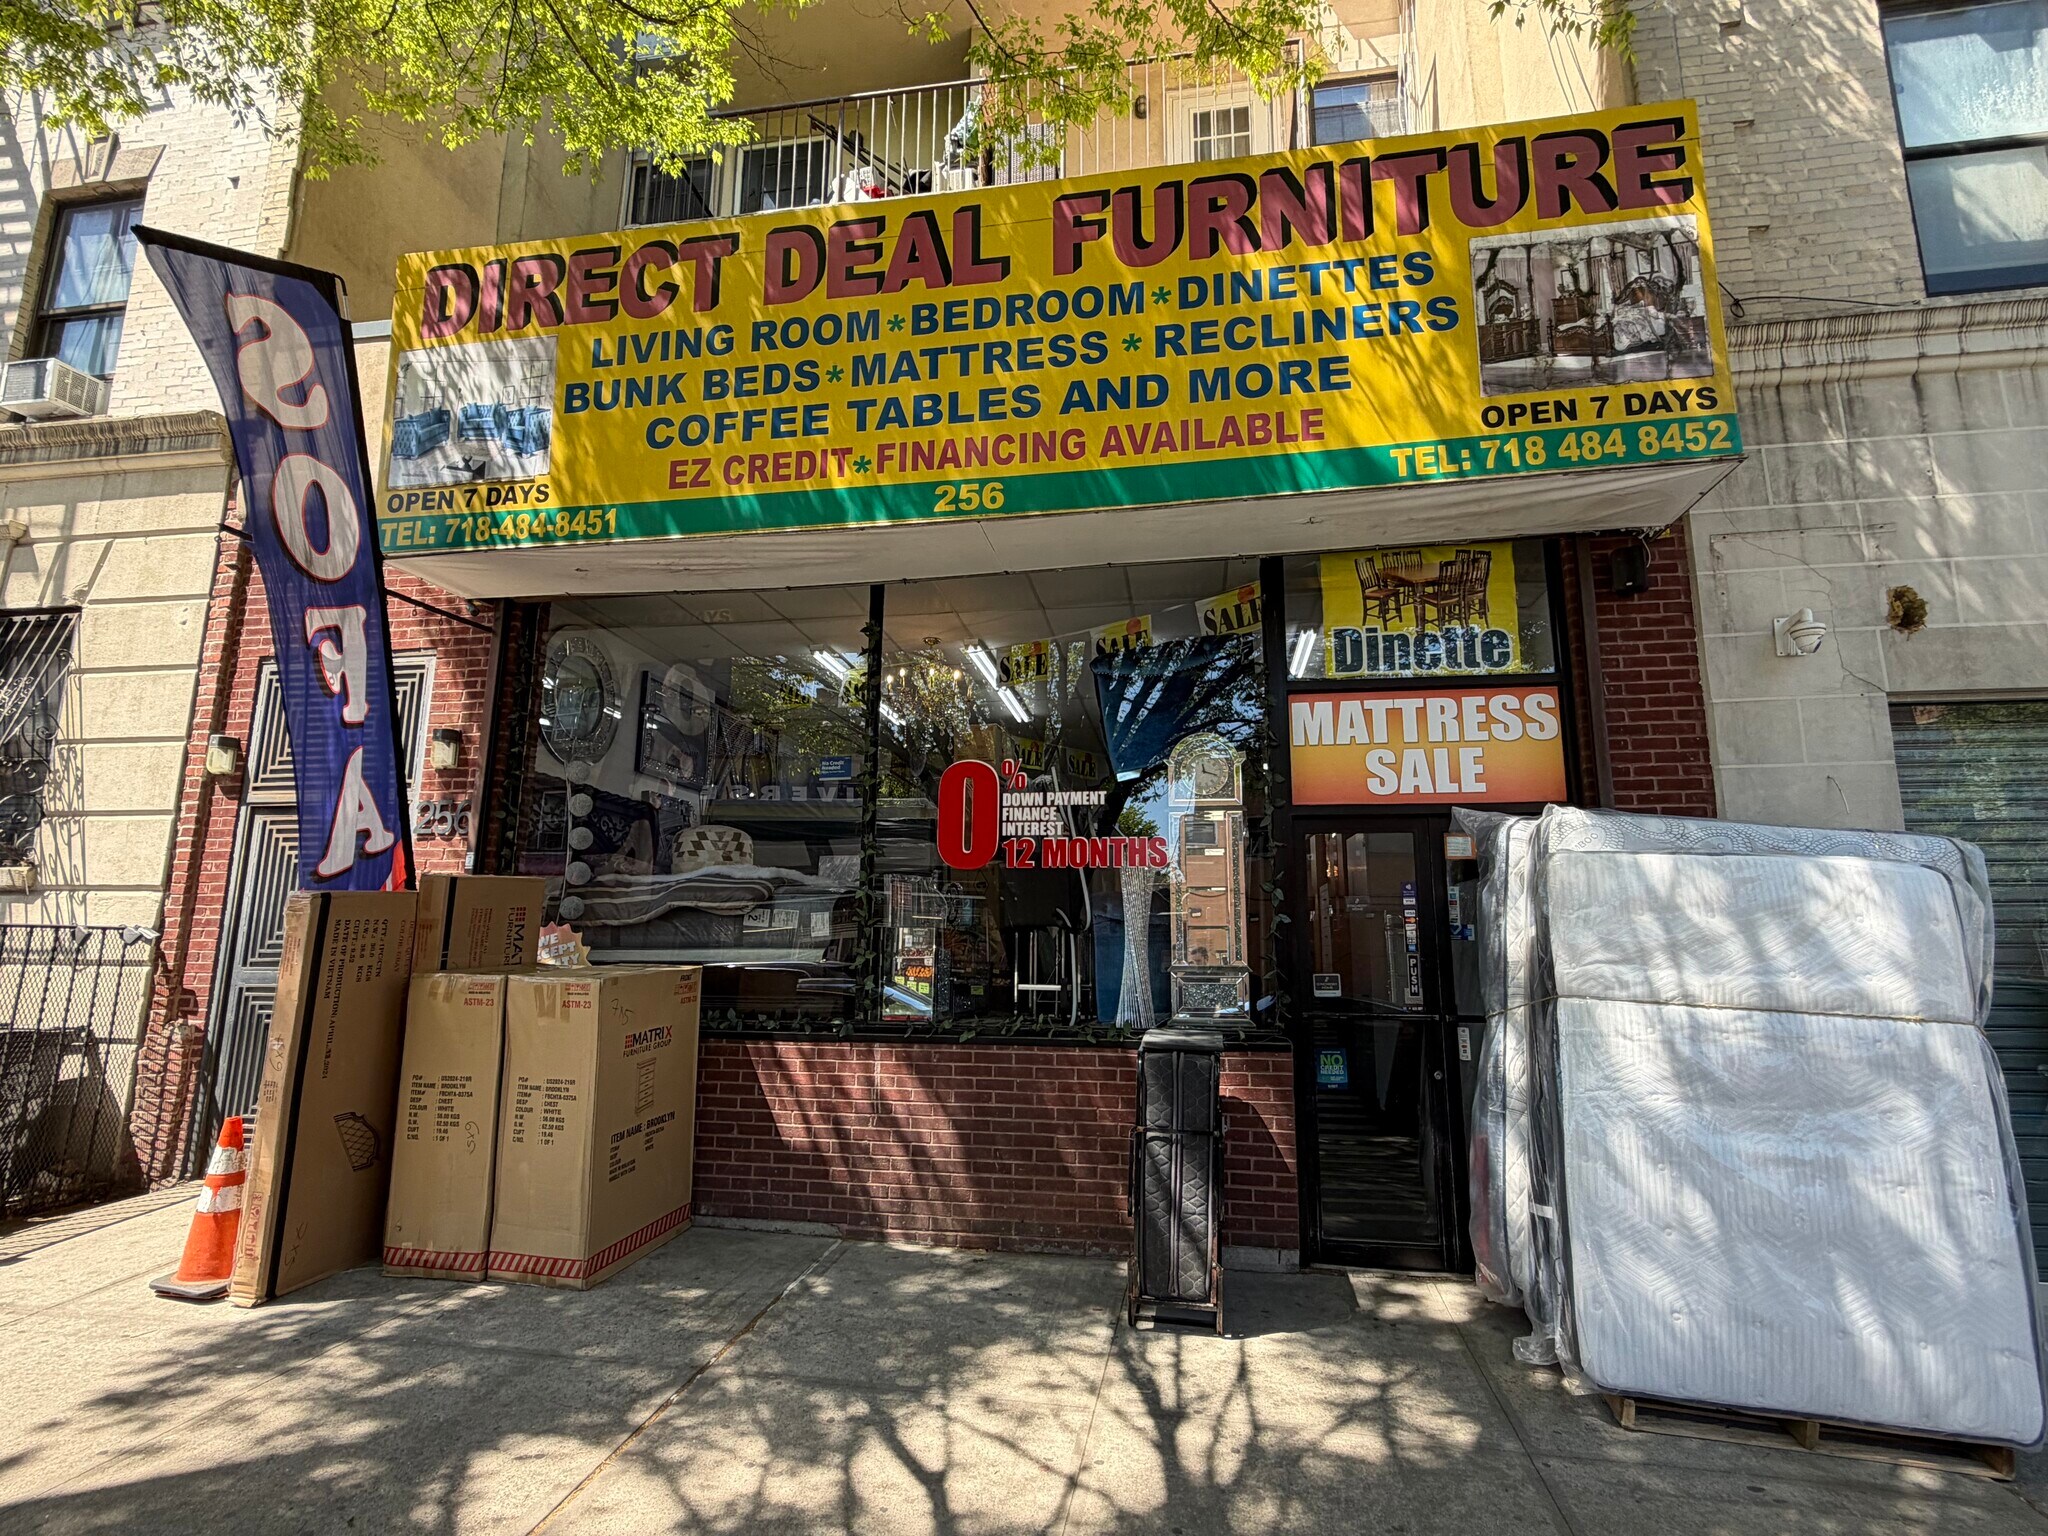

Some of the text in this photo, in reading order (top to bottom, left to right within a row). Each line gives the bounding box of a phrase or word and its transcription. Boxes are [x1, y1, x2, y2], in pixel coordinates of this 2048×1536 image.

[419, 116, 1694, 340] DIRECT DEAL FURNITURE
[592, 250, 1434, 368] LIVING ROOM BEDROOM DINETTES
[563, 295, 1459, 415] BUNK BEDS MATTRESS RECLINERS
[645, 354, 1352, 450] COFFEE TABLES AND MORE
[1481, 386, 1719, 429] OPEN 7 DAYS
[668, 407, 1327, 490] EZ CREDIT FINANCING AVAILABLE
[1389, 420, 1732, 477] TEL: 718 484 8452
[386, 483, 550, 514] OPEN 7 DAYS
[933, 481, 1006, 513] 256
[381, 508, 617, 547] TEL: 718-484-8451
[1332, 626, 1512, 674] Dinette
[1291, 693, 1560, 747] MATTRESS
[1365, 746, 1487, 796] SALE
[1002, 791, 1107, 806] DOWN PAYMENT
[1002, 807, 1057, 821] FINANCE
[413, 799, 473, 835] 256
[1002, 821, 1063, 836] INTEREST
[1002, 837, 1169, 869] 12 MONTHS
[540, 941, 576, 959] CEPT
[1410, 958, 1419, 994] PUSH
[463, 998, 494, 1006] ASTM-23
[562, 1000, 592, 1009] ASTM-23
[632, 1025, 673, 1047] MATRIX
[1320, 1054, 1343, 1065] NO
[610, 1130, 625, 1145] ITEM
[626, 1122, 643, 1138] NAME
[646, 1110, 676, 1129] BROOKLYN
